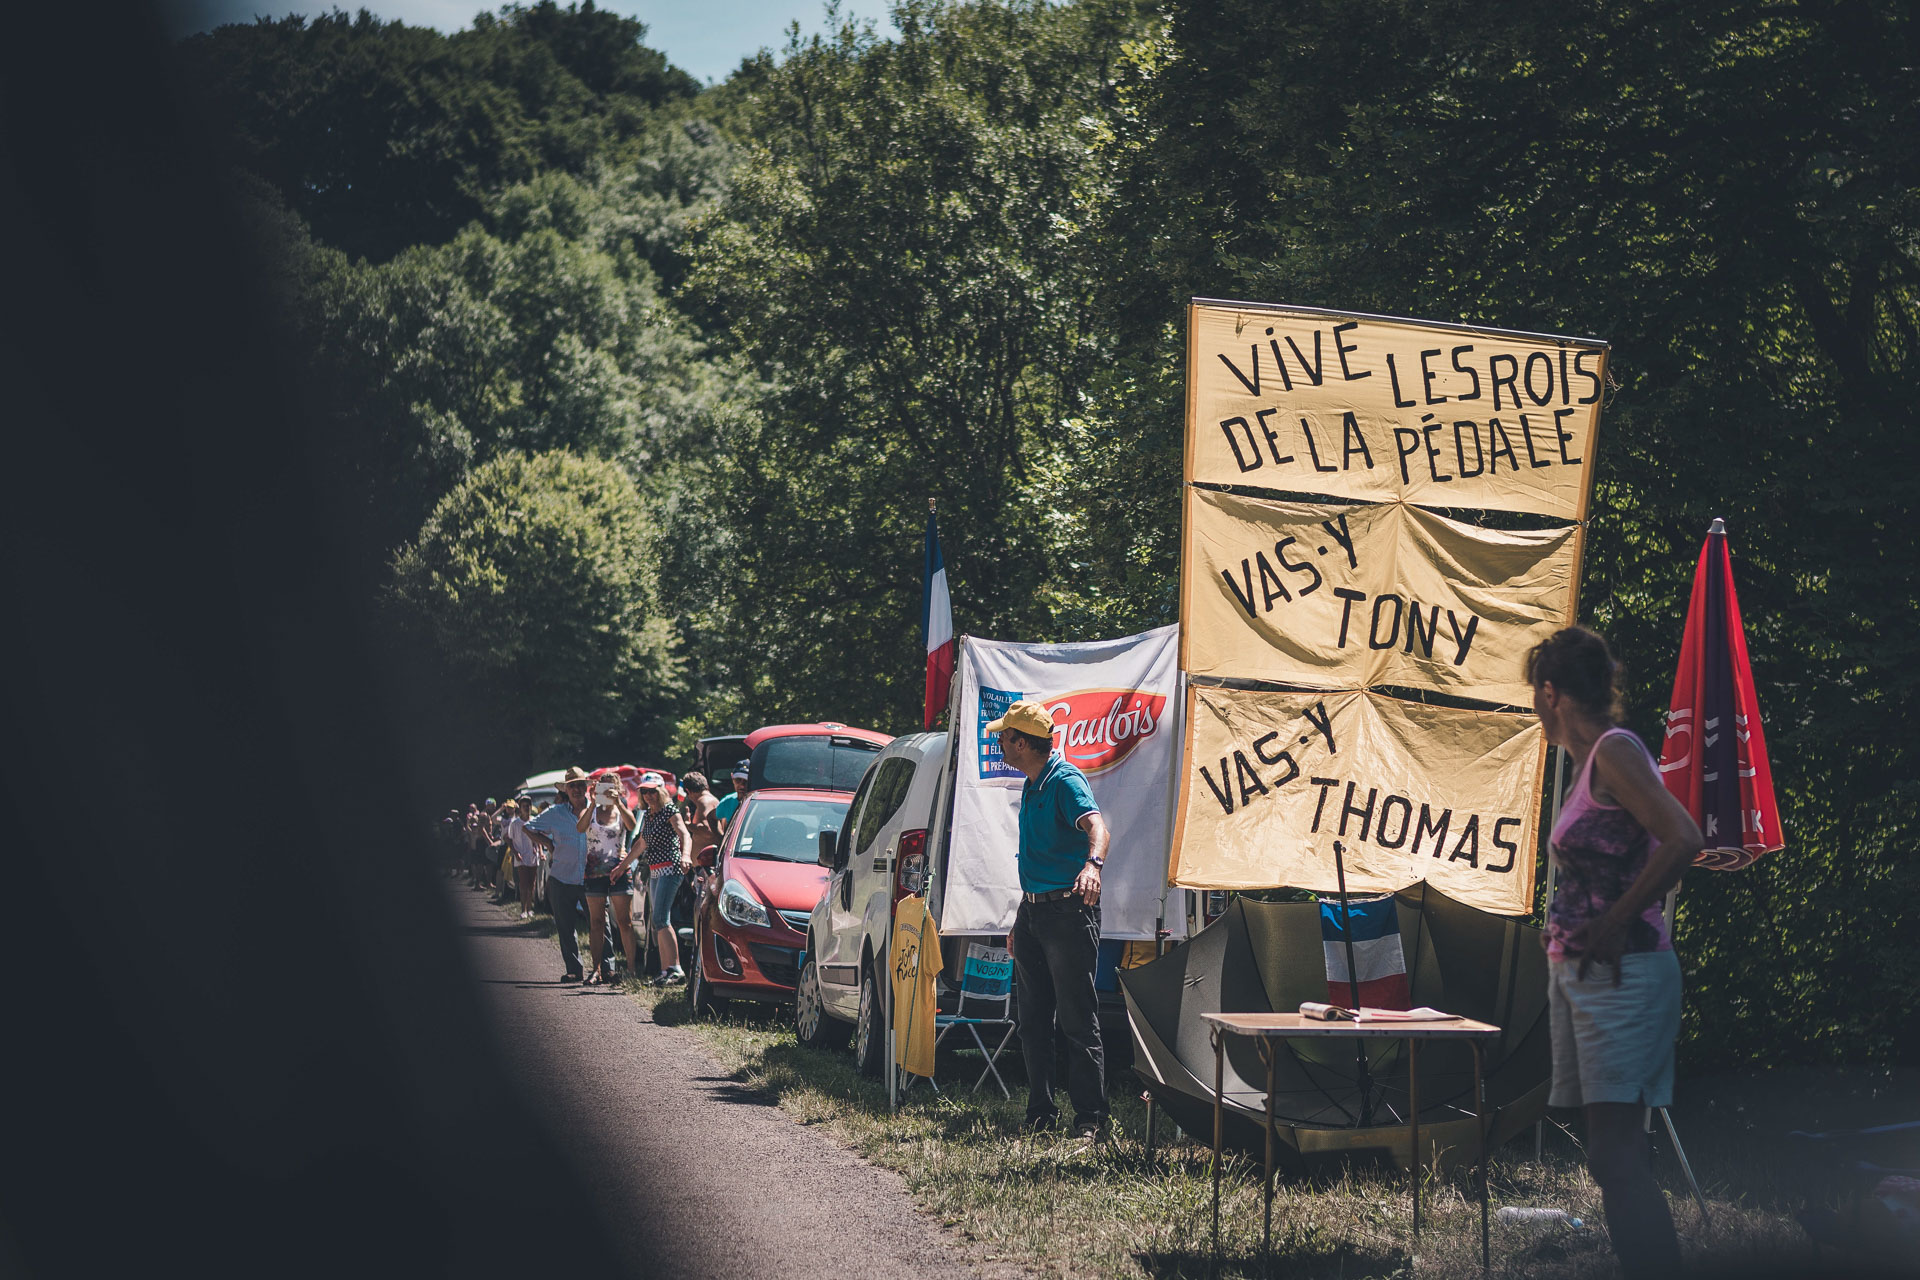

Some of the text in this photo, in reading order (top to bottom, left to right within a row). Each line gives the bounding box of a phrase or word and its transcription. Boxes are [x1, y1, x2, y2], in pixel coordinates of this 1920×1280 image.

[1387, 345, 1480, 408] LES
[1220, 408, 1583, 485] DE LA PÉDALE
[1334, 588, 1479, 666] TONY
[1047, 696, 1154, 761] Gaulois
[1311, 777, 1521, 873] THOMAS
